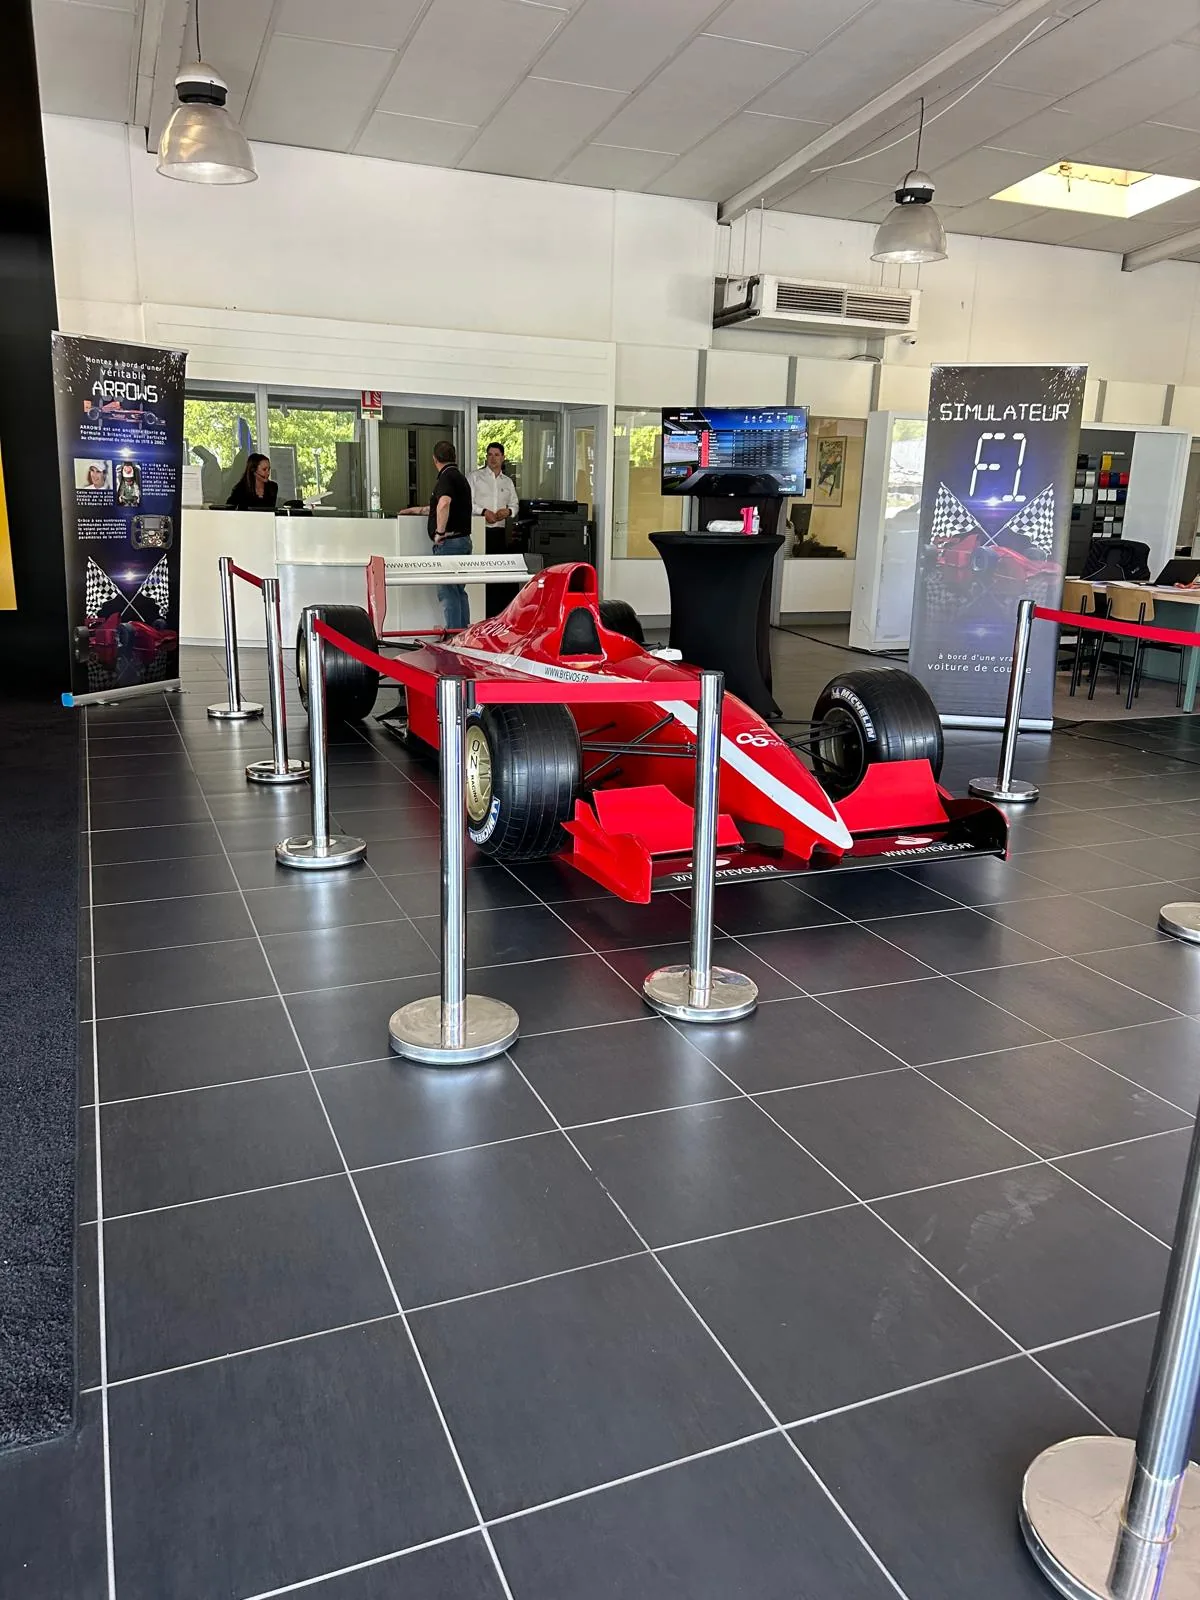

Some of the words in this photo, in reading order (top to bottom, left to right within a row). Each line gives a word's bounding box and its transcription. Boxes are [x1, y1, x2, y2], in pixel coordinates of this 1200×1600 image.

[85, 356, 112, 365] Montez
[100, 367, 147, 381] véritable
[92, 380, 158, 403] ARROWS
[940, 403, 1069, 421] SIMULATEUR
[969, 432, 1026, 502] F1
[459, 559, 517, 568] WWW.BYEVOS.FR
[938, 652, 944, 660] à
[971, 654, 996, 662] d'une
[544, 666, 589, 682] WWW.BYEVOS.FR
[927, 663, 969, 672] voiture
[974, 664, 988, 672] de
[993, 665, 1032, 674] coue
[840, 688, 875, 738] MICHELIN
[881, 842, 975, 857] WWW.BYEVOS.FR
